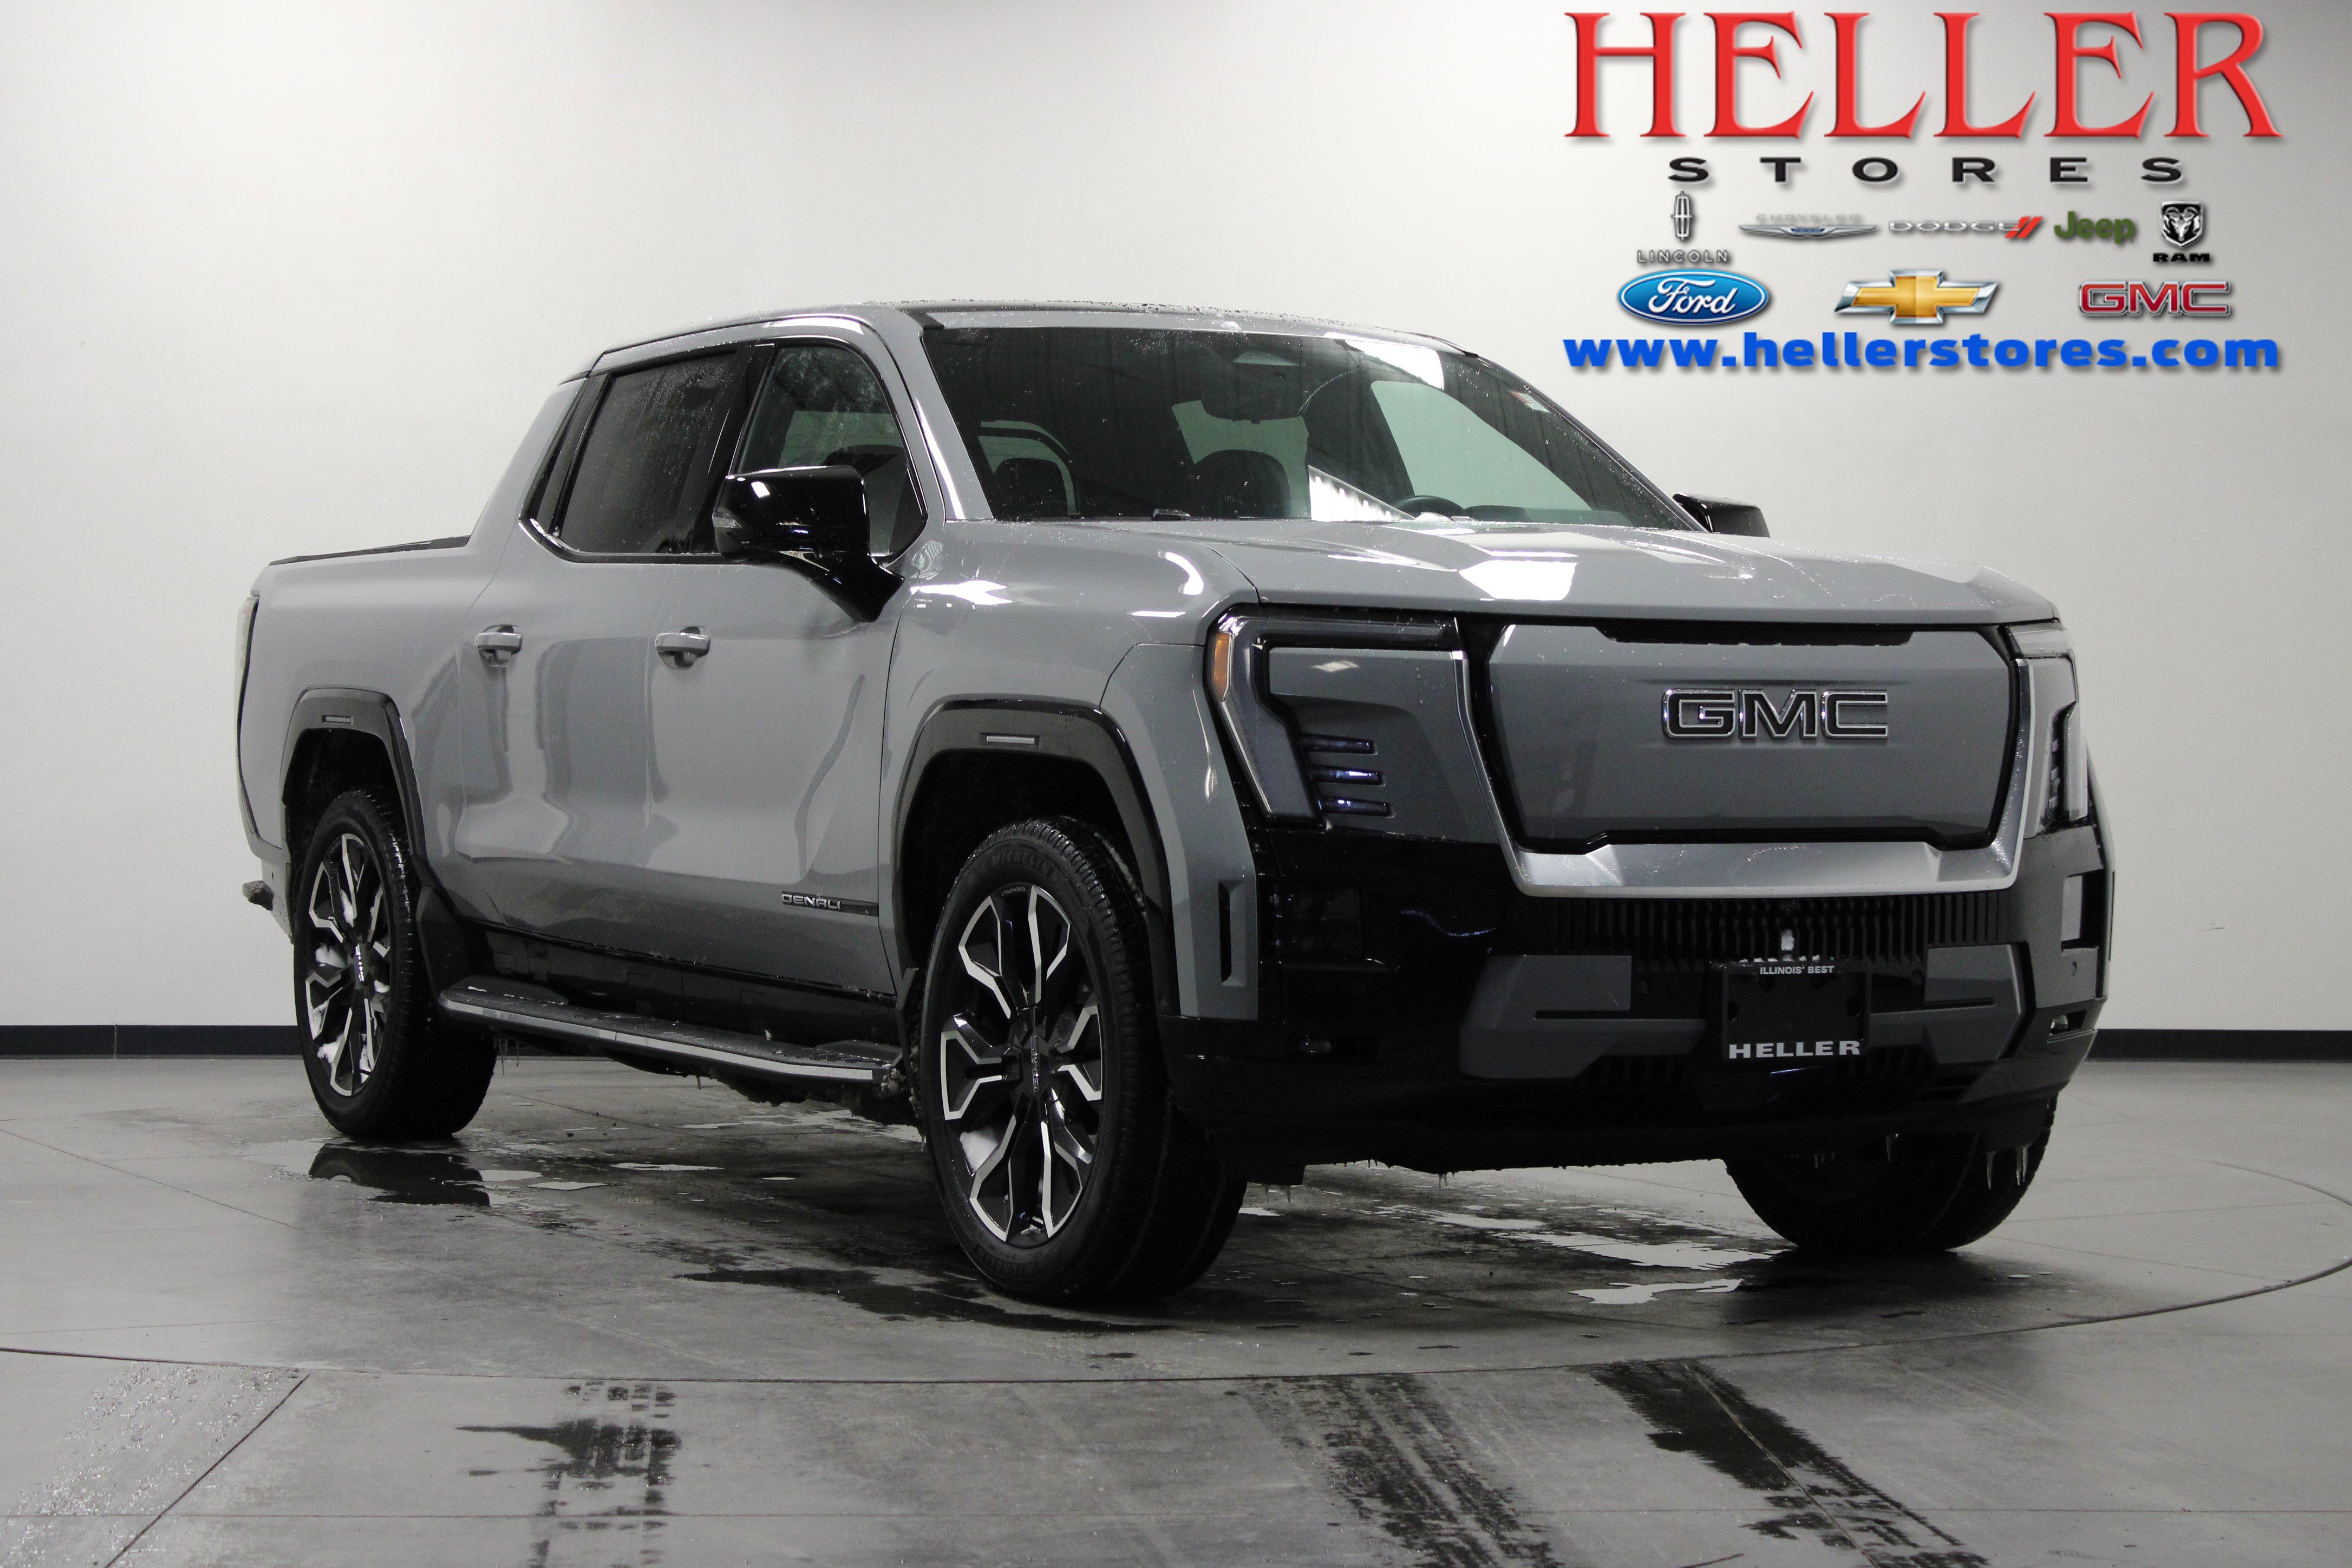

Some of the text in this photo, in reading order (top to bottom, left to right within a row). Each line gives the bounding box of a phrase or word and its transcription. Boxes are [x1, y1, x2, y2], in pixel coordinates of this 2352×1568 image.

[1661, 688, 1888, 739] GMC
[781, 893, 841, 910] DENALI
[1807, 965, 1834, 974] BEST
[1729, 1041, 1860, 1059] HELLER
